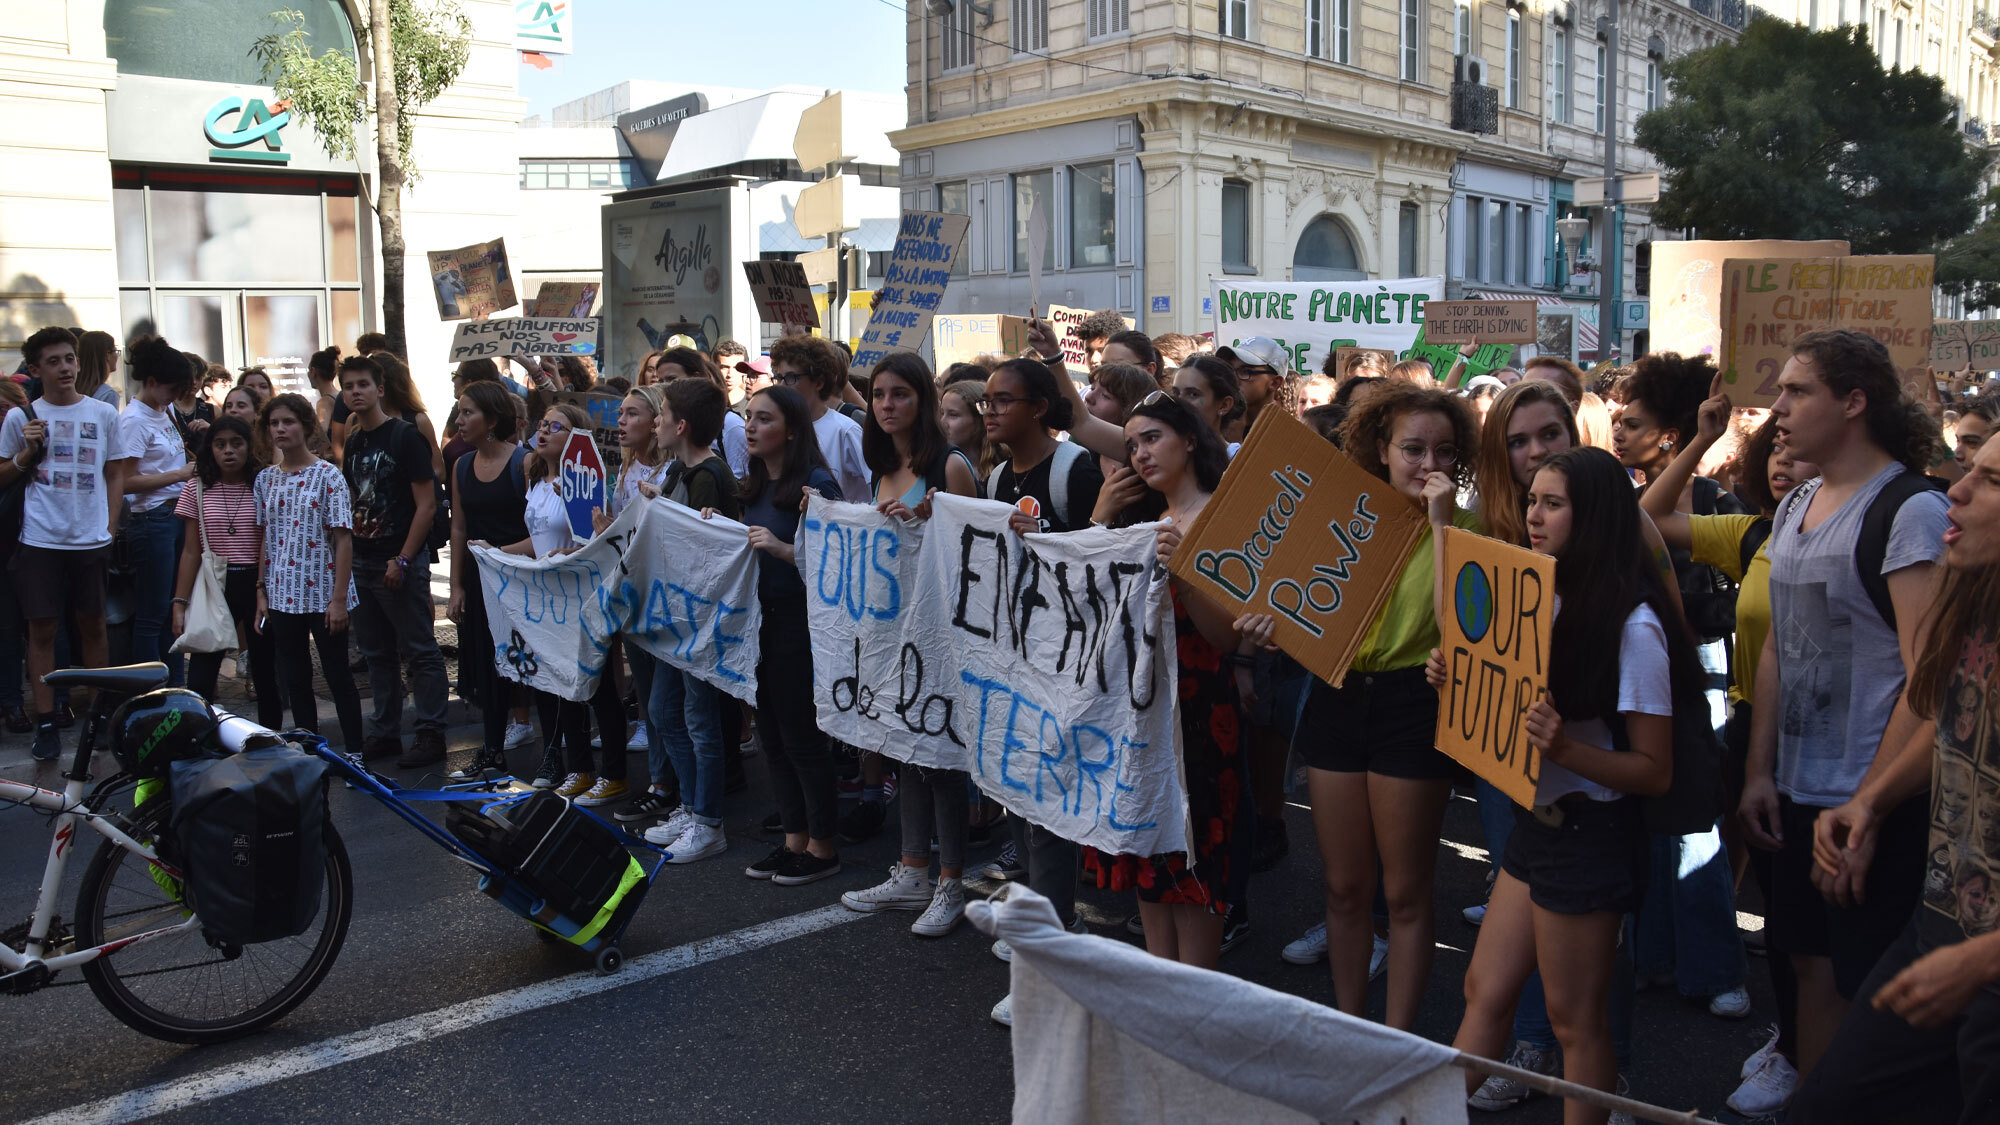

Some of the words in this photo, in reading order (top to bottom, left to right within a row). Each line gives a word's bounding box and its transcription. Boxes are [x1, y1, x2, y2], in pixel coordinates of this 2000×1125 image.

[630, 117, 656, 133] GALERIES
[657, 107, 688, 125] LAFAYETTE
[900, 214, 928, 237] NOUS
[926, 216, 944, 240] NE
[433, 261, 449, 272] UP
[654, 223, 712, 286] Argilla
[745, 262, 766, 285] ON
[769, 262, 808, 289] NIQUE
[885, 262, 904, 284] PAS
[904, 266, 920, 285] LA
[1746, 263, 1778, 292] LE
[765, 301, 814, 326] TERRE
[1219, 288, 1298, 323] NOTRE
[1308, 285, 1430, 324] PLANÈTE
[1446, 305, 1470, 317] STOP
[1473, 305, 1509, 317] DENYING
[462, 319, 595, 336] RÉCHAUFFONS
[869, 308, 885, 325] LA
[884, 310, 921, 328] NATURE
[1428, 319, 1450, 335] THE
[1453, 318, 1484, 334] EARTH
[1488, 319, 1496, 334] IS
[1498, 318, 1528, 334] DYING
[499, 331, 541, 342] NOS
[862, 330, 881, 344] QUI
[882, 330, 902, 347] SE
[939, 317, 963, 347] PAS
[969, 319, 996, 333] DE
[455, 341, 498, 358] PAS
[511, 341, 573, 354] NOTRE
[563, 450, 598, 503] STOP
[1195, 464, 1312, 603] Broccoli
[1455, 561, 1542, 676] OUR
[833, 637, 880, 721] de
[896, 642, 968, 750] la
[961, 669, 1157, 832] TERRE
